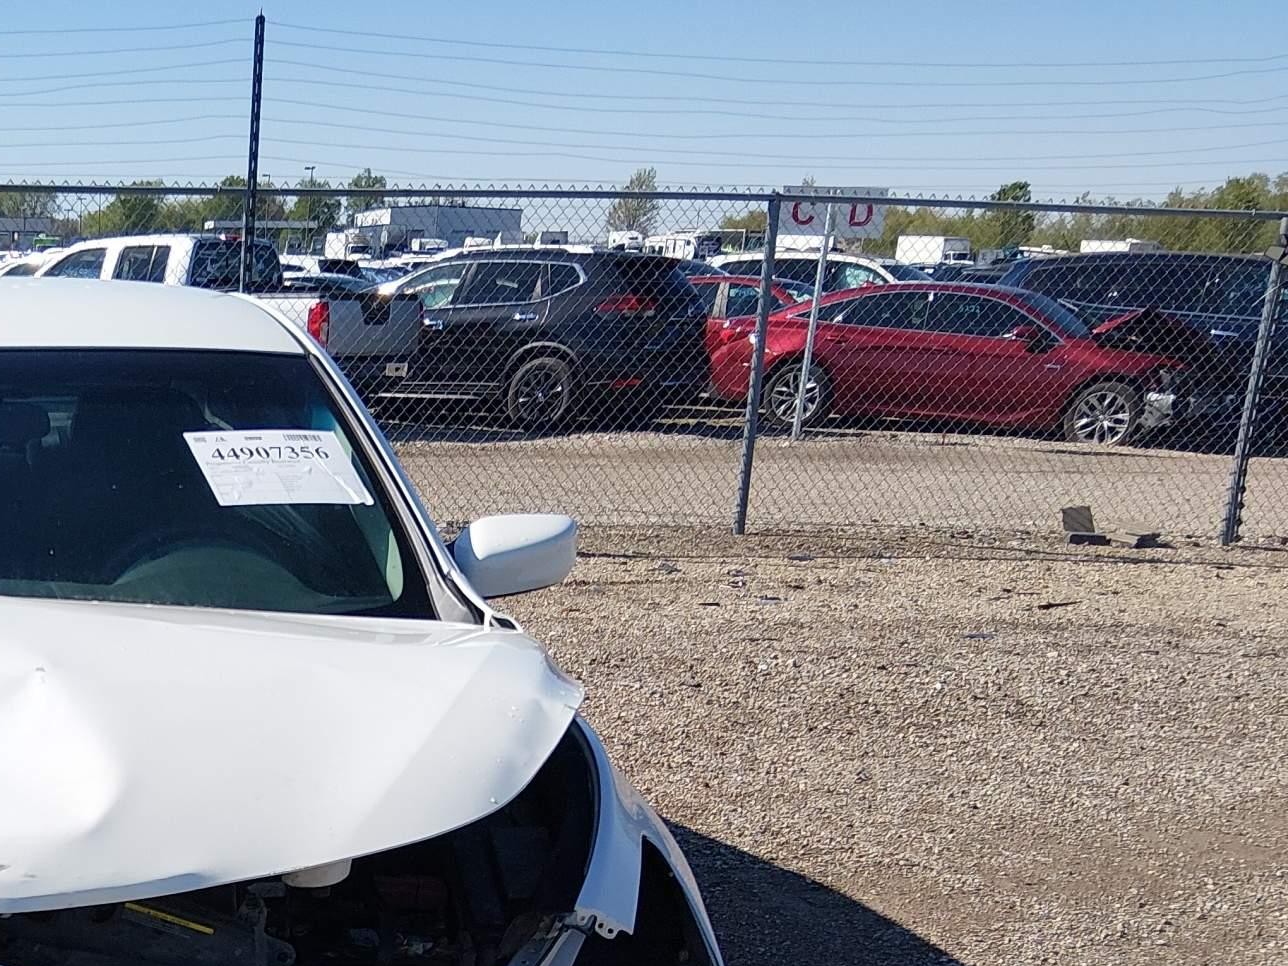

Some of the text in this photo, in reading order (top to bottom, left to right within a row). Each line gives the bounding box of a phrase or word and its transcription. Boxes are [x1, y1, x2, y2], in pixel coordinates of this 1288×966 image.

[792, 202, 874, 226] C D
[211, 446, 330, 460] 44907356
